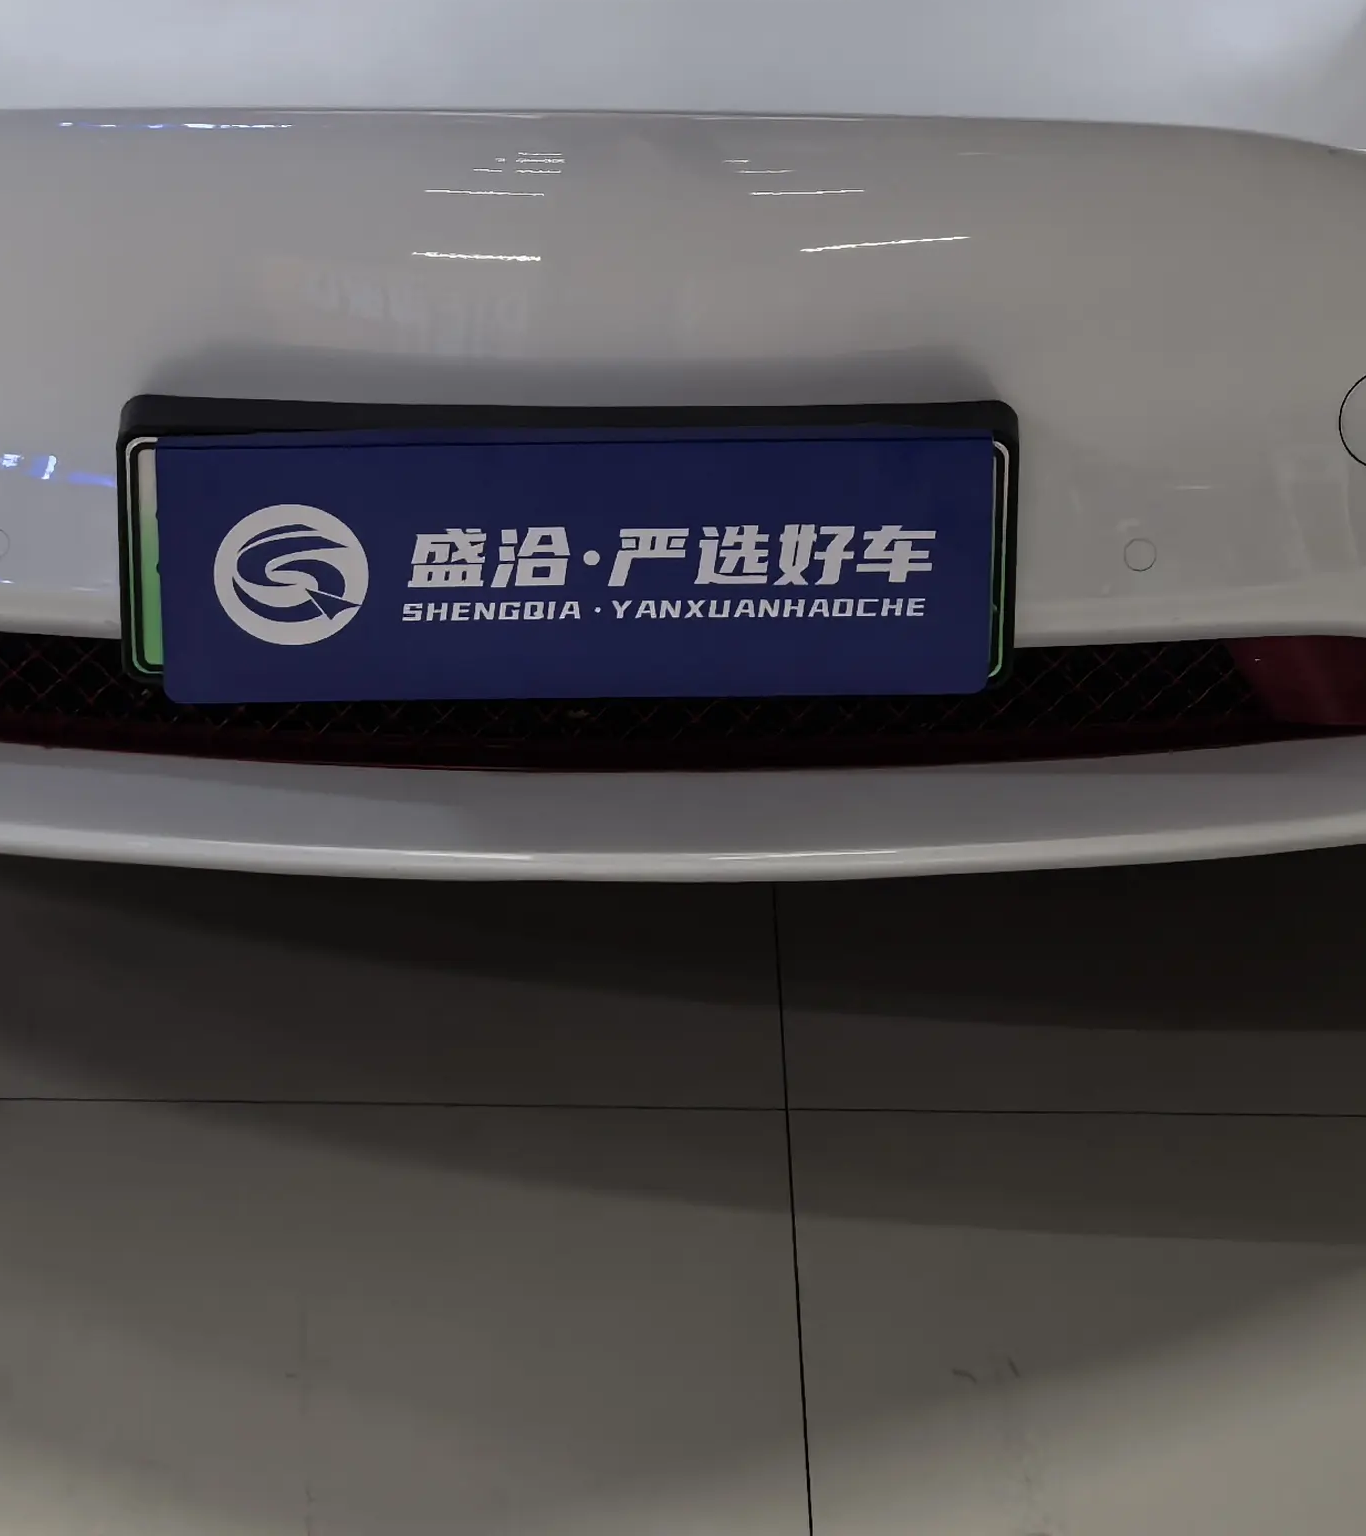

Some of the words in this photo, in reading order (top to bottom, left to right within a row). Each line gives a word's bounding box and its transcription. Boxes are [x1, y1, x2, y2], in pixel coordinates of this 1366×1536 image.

[407, 524, 937, 588] 盛洽·严选好车
[402, 600, 581, 622] SHENGQIA
[611, 598, 926, 620] YANXUANHAOCHE
